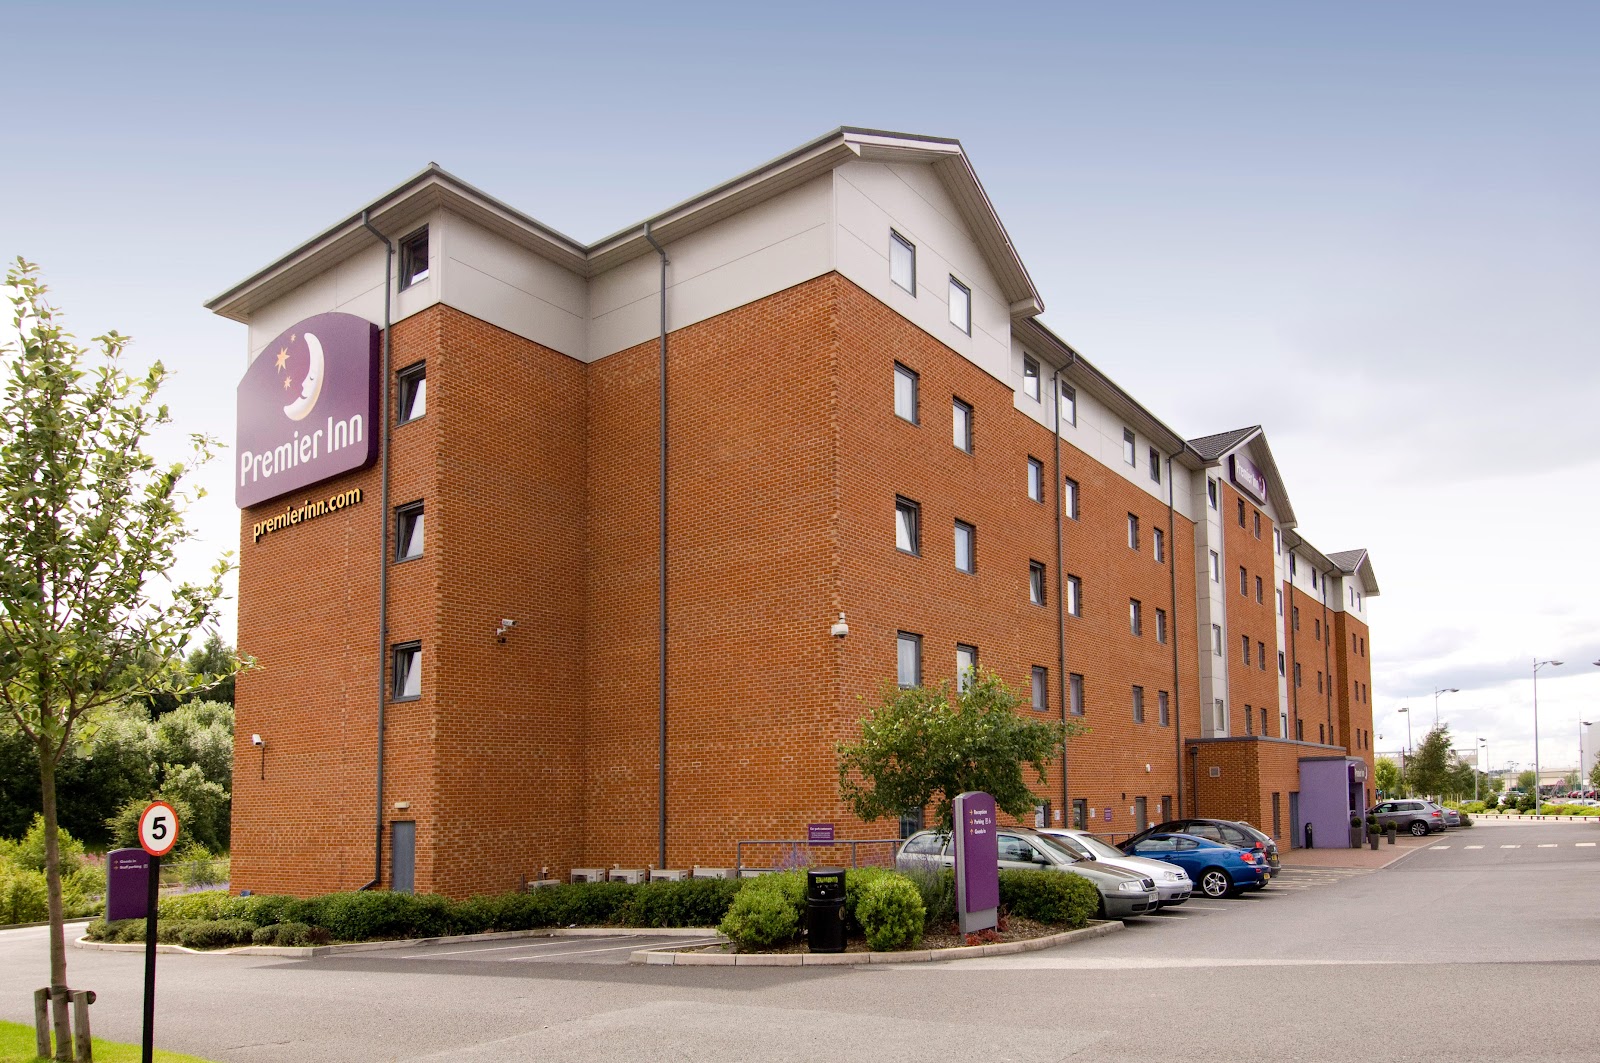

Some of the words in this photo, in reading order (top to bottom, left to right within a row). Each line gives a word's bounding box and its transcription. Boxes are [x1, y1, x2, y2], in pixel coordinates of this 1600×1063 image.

[241, 430, 323, 487] Premier
[327, 414, 363, 454] Inn
[253, 488, 361, 543] premierinn.com
[152, 816, 167, 840] 5
